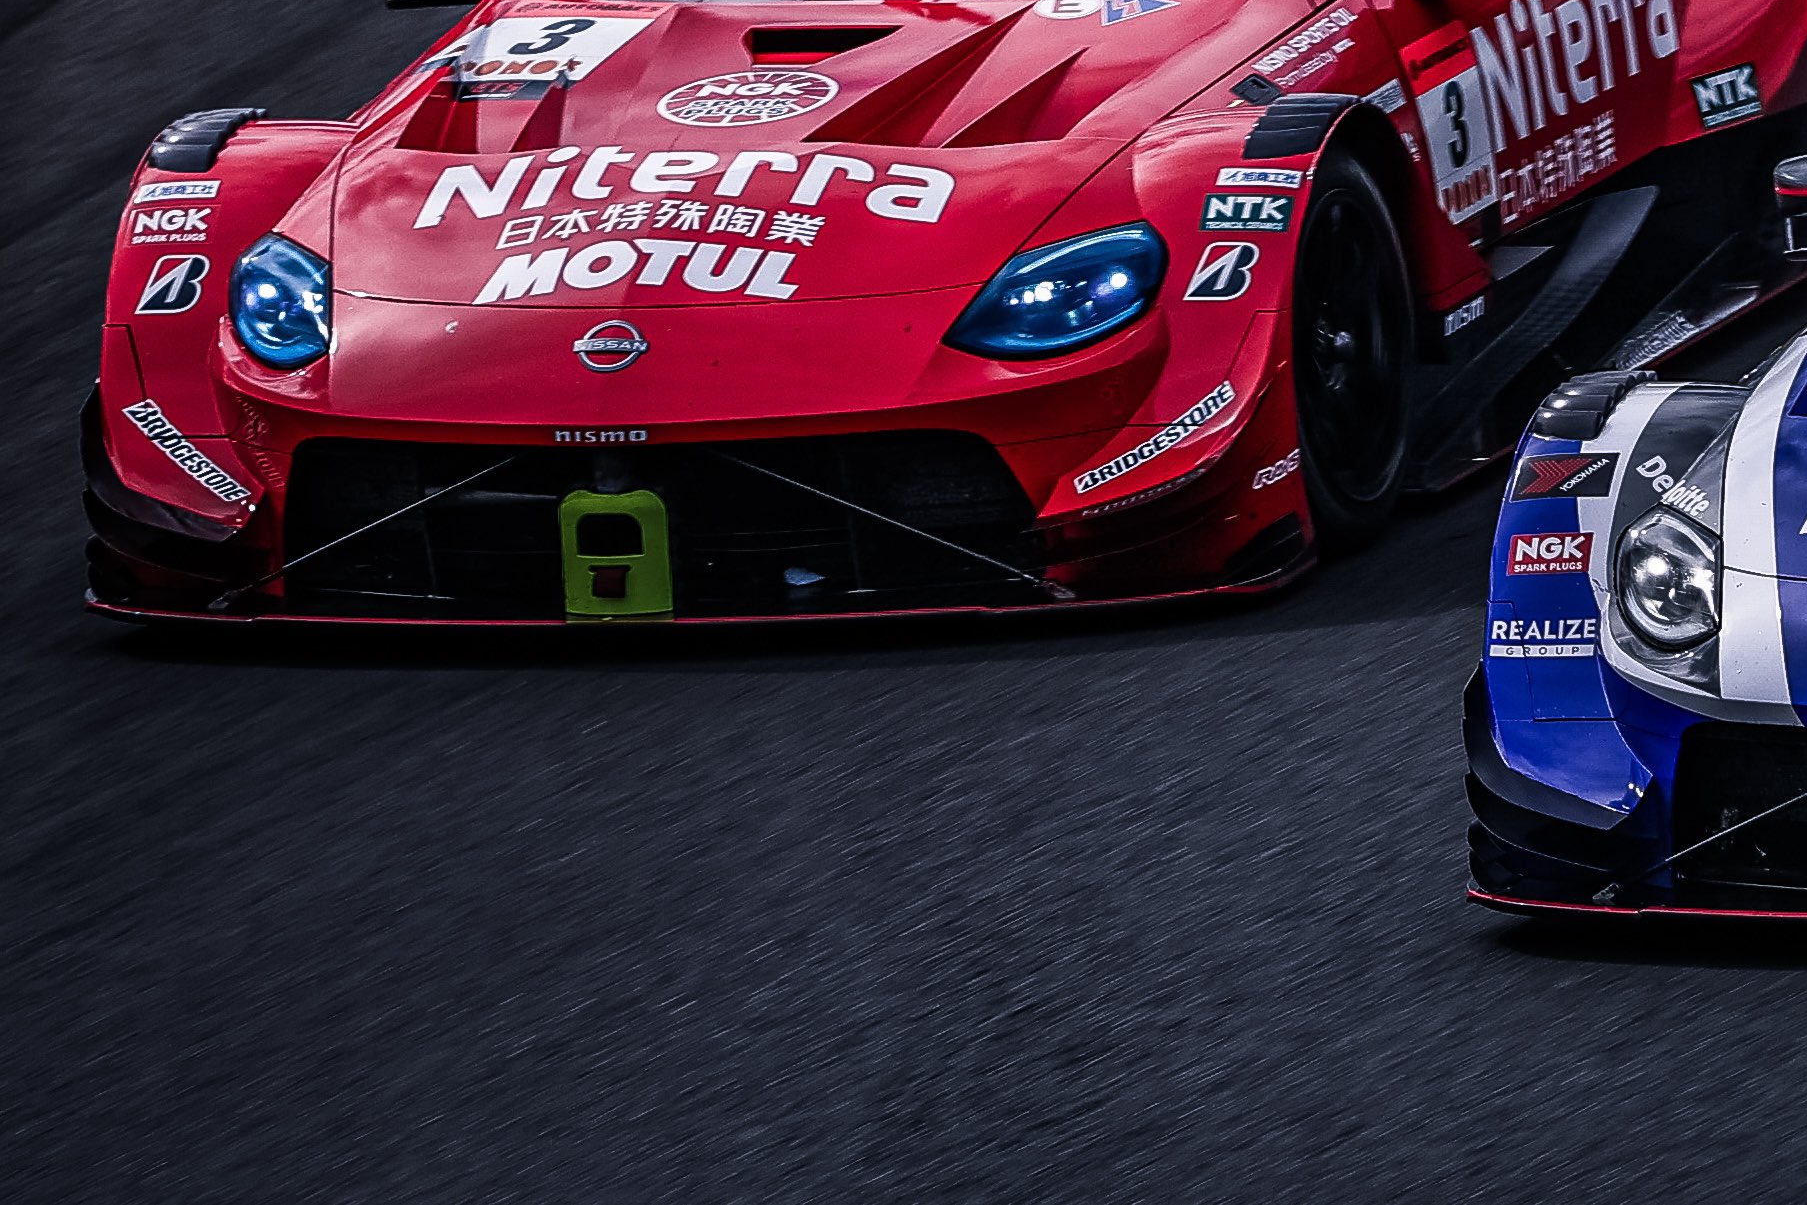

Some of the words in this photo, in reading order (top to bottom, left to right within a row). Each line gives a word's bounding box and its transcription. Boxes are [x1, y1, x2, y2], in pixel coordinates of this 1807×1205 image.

[507, 19, 598, 55] 3
[703, 82, 814, 97] NGK
[1692, 64, 1758, 113] NTK
[684, 106, 787, 117] PLUGS
[691, 98, 792, 108] SPARK
[1444, 80, 1470, 169] 3
[413, 145, 957, 230] Niterra
[133, 208, 213, 234] NGK
[1206, 196, 1289, 220] NTK
[496, 198, 827, 251] 日本特殊陶業
[131, 233, 168, 244] SPARK
[169, 232, 207, 242] PLUGS
[472, 237, 800, 306] MOTUL
[574, 340, 648, 352] NISSAN
[555, 429, 648, 443] nismo
[1074, 380, 1236, 495] BRIDGESTONE
[121, 398, 251, 502] BRIDGESTONE
[1559, 458, 1610, 492] YOKOHAMA
[1636, 455, 1710, 517] Deloitte
[1515, 535, 1586, 562] NGK
[1514, 563, 1547, 572] SPARK
[1550, 562, 1583, 571] PLUGS
[1491, 619, 1597, 640] REALIZE
[1506, 646, 1580, 656] GROUP
